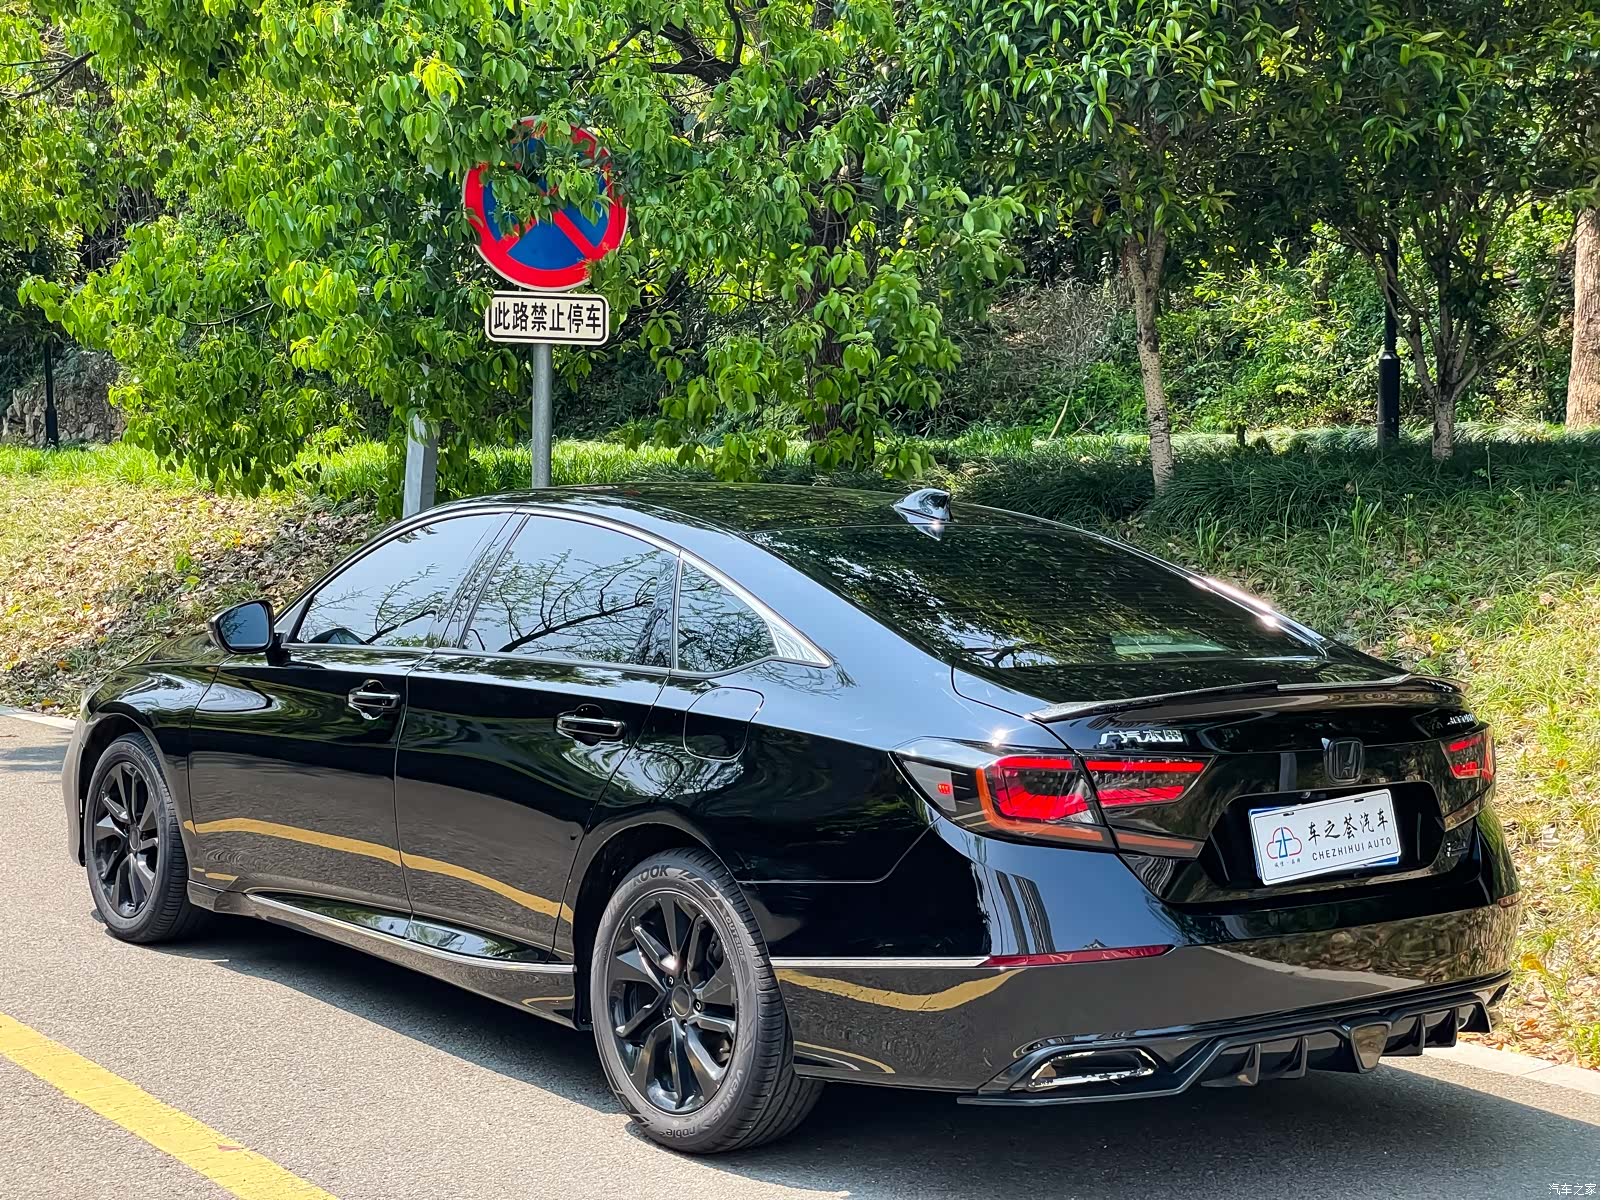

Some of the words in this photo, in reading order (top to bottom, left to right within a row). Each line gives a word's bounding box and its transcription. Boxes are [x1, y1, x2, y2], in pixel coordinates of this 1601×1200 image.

[494, 301, 601, 333] 此路禁止停车
[1308, 807, 1389, 846] 车之荟汽车
[1312, 843, 1365, 861] CHEZHIHUI
[1368, 836, 1392, 849] AUTO
[726, 916, 747, 962] OUTSIDE
